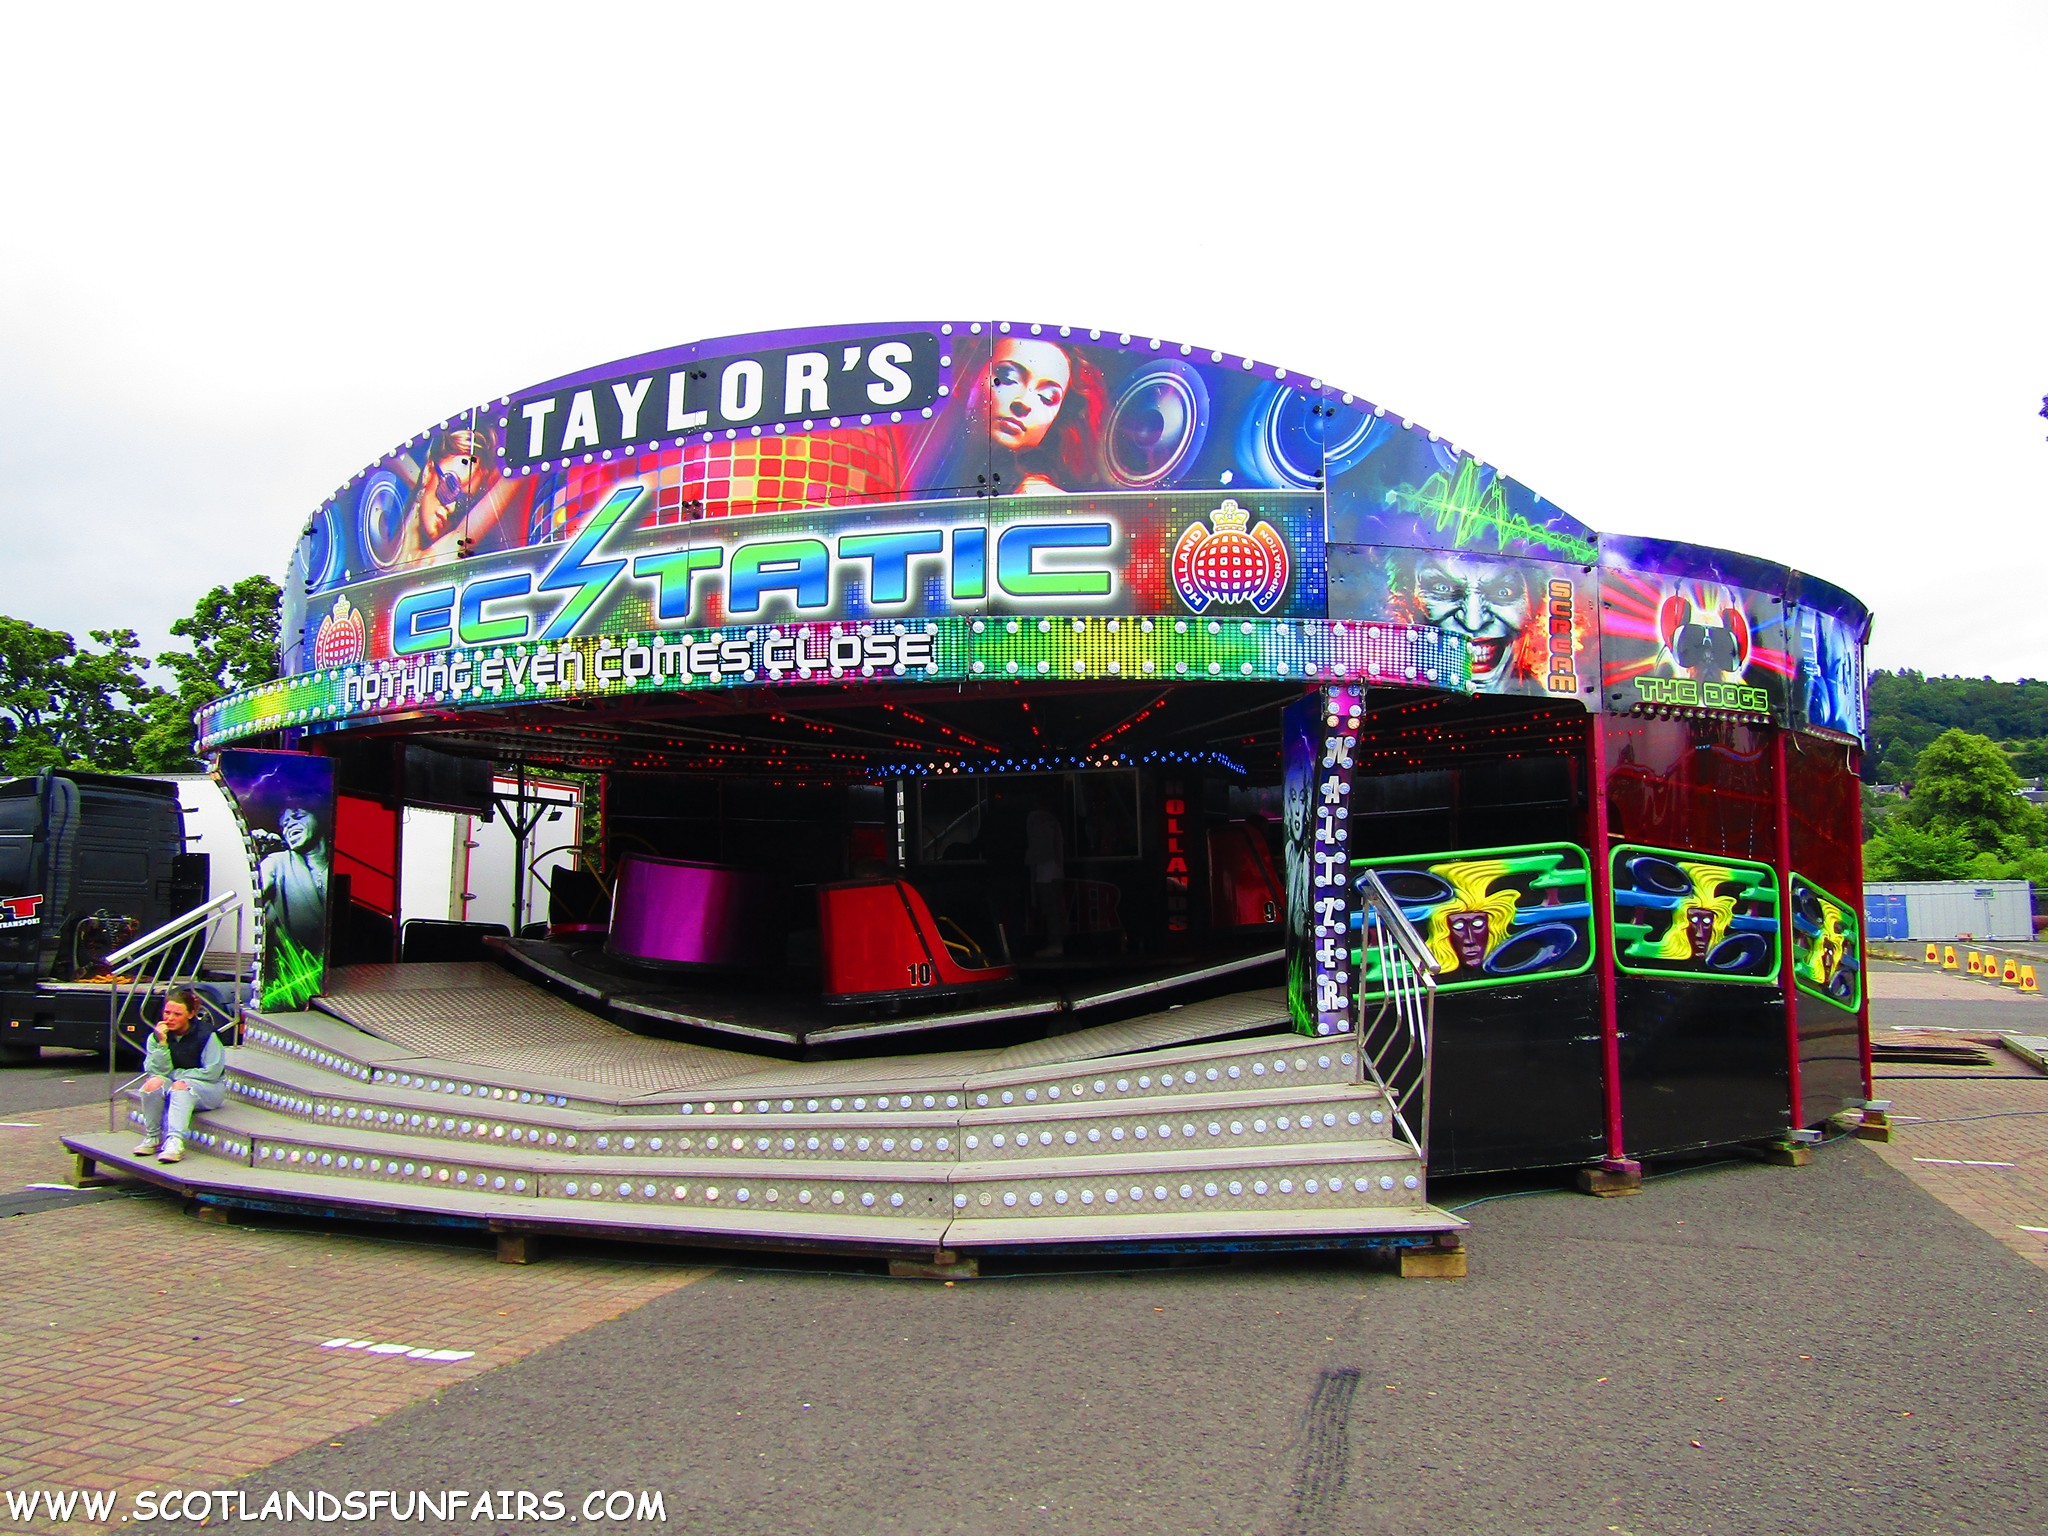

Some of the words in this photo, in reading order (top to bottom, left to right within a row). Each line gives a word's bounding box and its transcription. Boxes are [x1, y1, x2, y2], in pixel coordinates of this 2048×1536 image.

[522, 341, 913, 459] TAYLOR'S
[1179, 530, 1203, 606] HOLLAND
[1259, 530, 1282, 606] CORPORATION
[346, 660, 472, 703] NOTHING
[481, 651, 583, 688] EVEN
[595, 640, 751, 678] COMES
[763, 635, 933, 669] CLOSE
[1548, 578, 1577, 694] SCREAM
[1635, 677, 1698, 705] THE
[1704, 682, 1769, 712] DOGS
[897, 791, 906, 868] HOLL
[1324, 737, 1349, 1010] WALTZER
[1264, 901, 1277, 923] 9
[907, 962, 931, 986] 10
